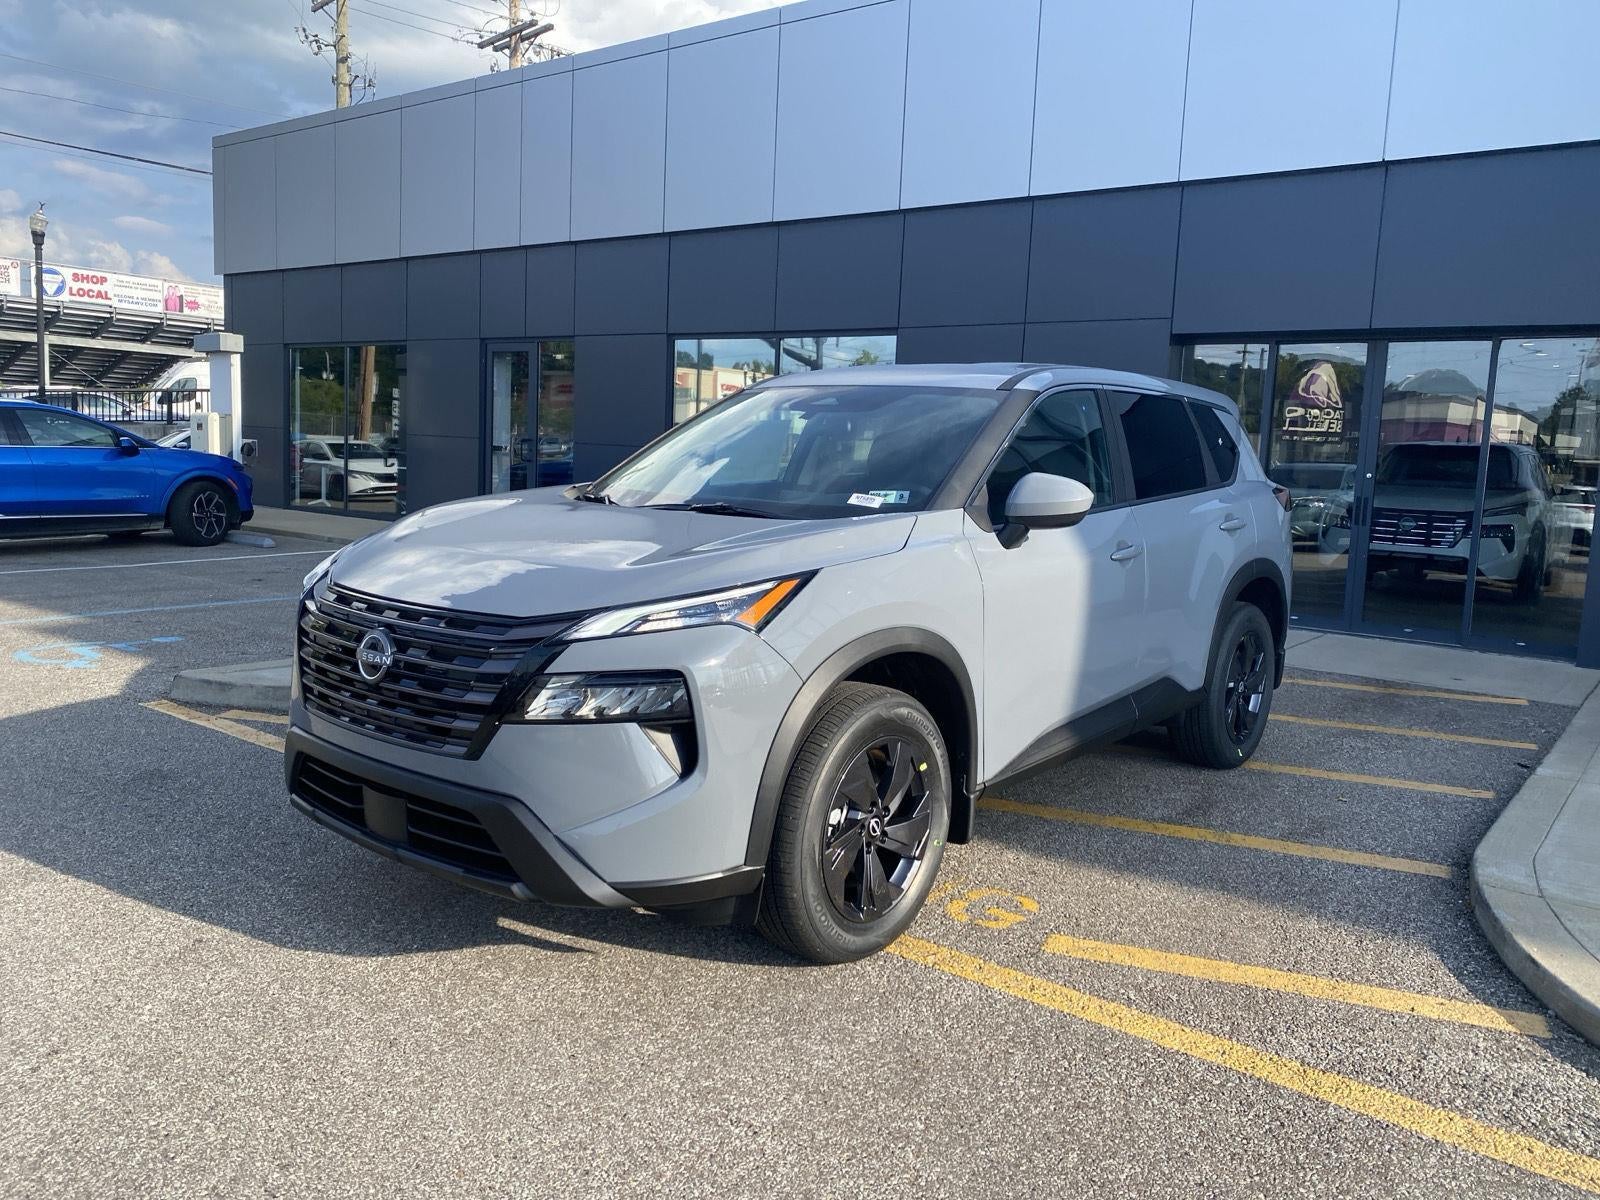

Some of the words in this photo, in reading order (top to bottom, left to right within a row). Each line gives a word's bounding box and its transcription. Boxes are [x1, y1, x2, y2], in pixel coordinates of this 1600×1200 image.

[72, 272, 108, 286] SHOP
[69, 286, 112, 301] LOCAL
[358, 650, 391, 666] SSAN
